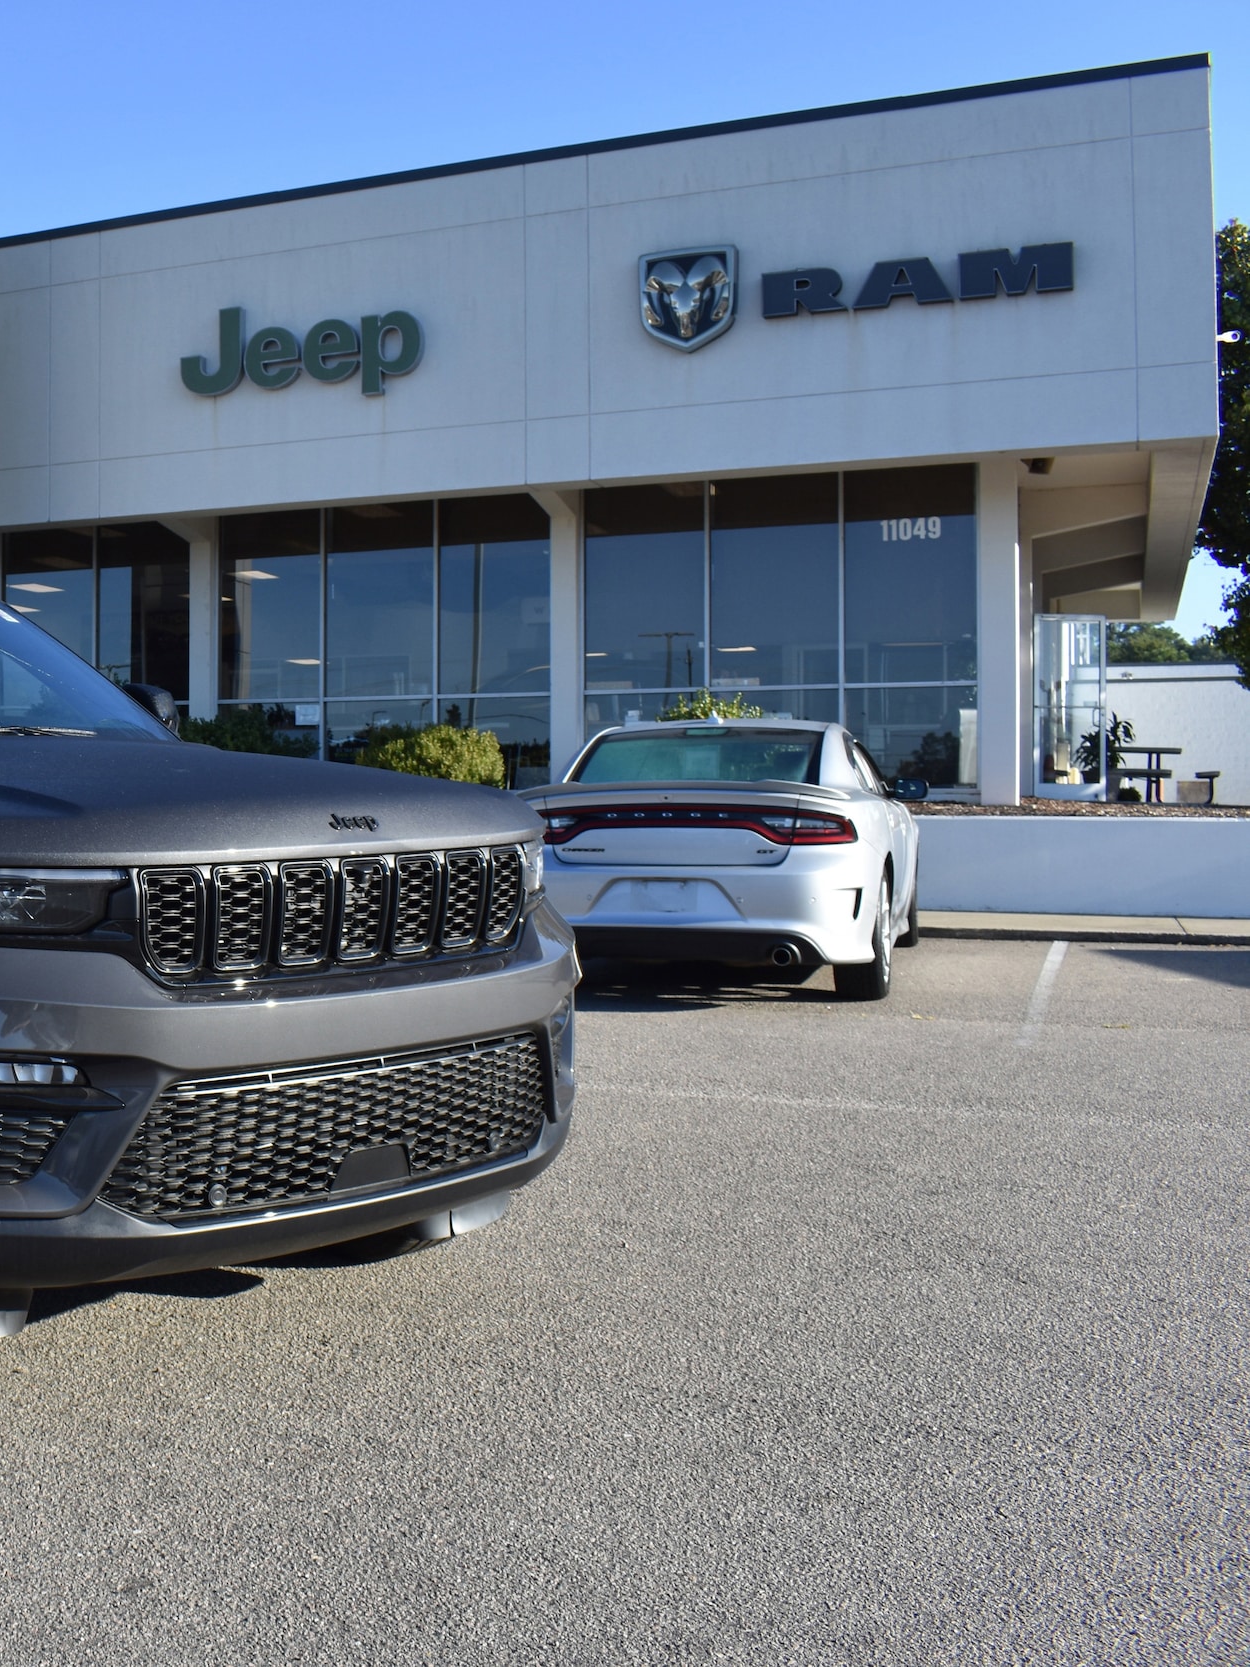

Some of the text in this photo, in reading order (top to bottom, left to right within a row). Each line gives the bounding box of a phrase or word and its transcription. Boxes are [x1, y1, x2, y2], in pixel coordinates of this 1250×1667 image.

[760, 241, 1074, 320] RAM
[180, 306, 425, 396] Jeep
[880, 516, 942, 541] 11049
[328, 813, 379, 832] Jeep
[606, 811, 729, 819] DODGE
